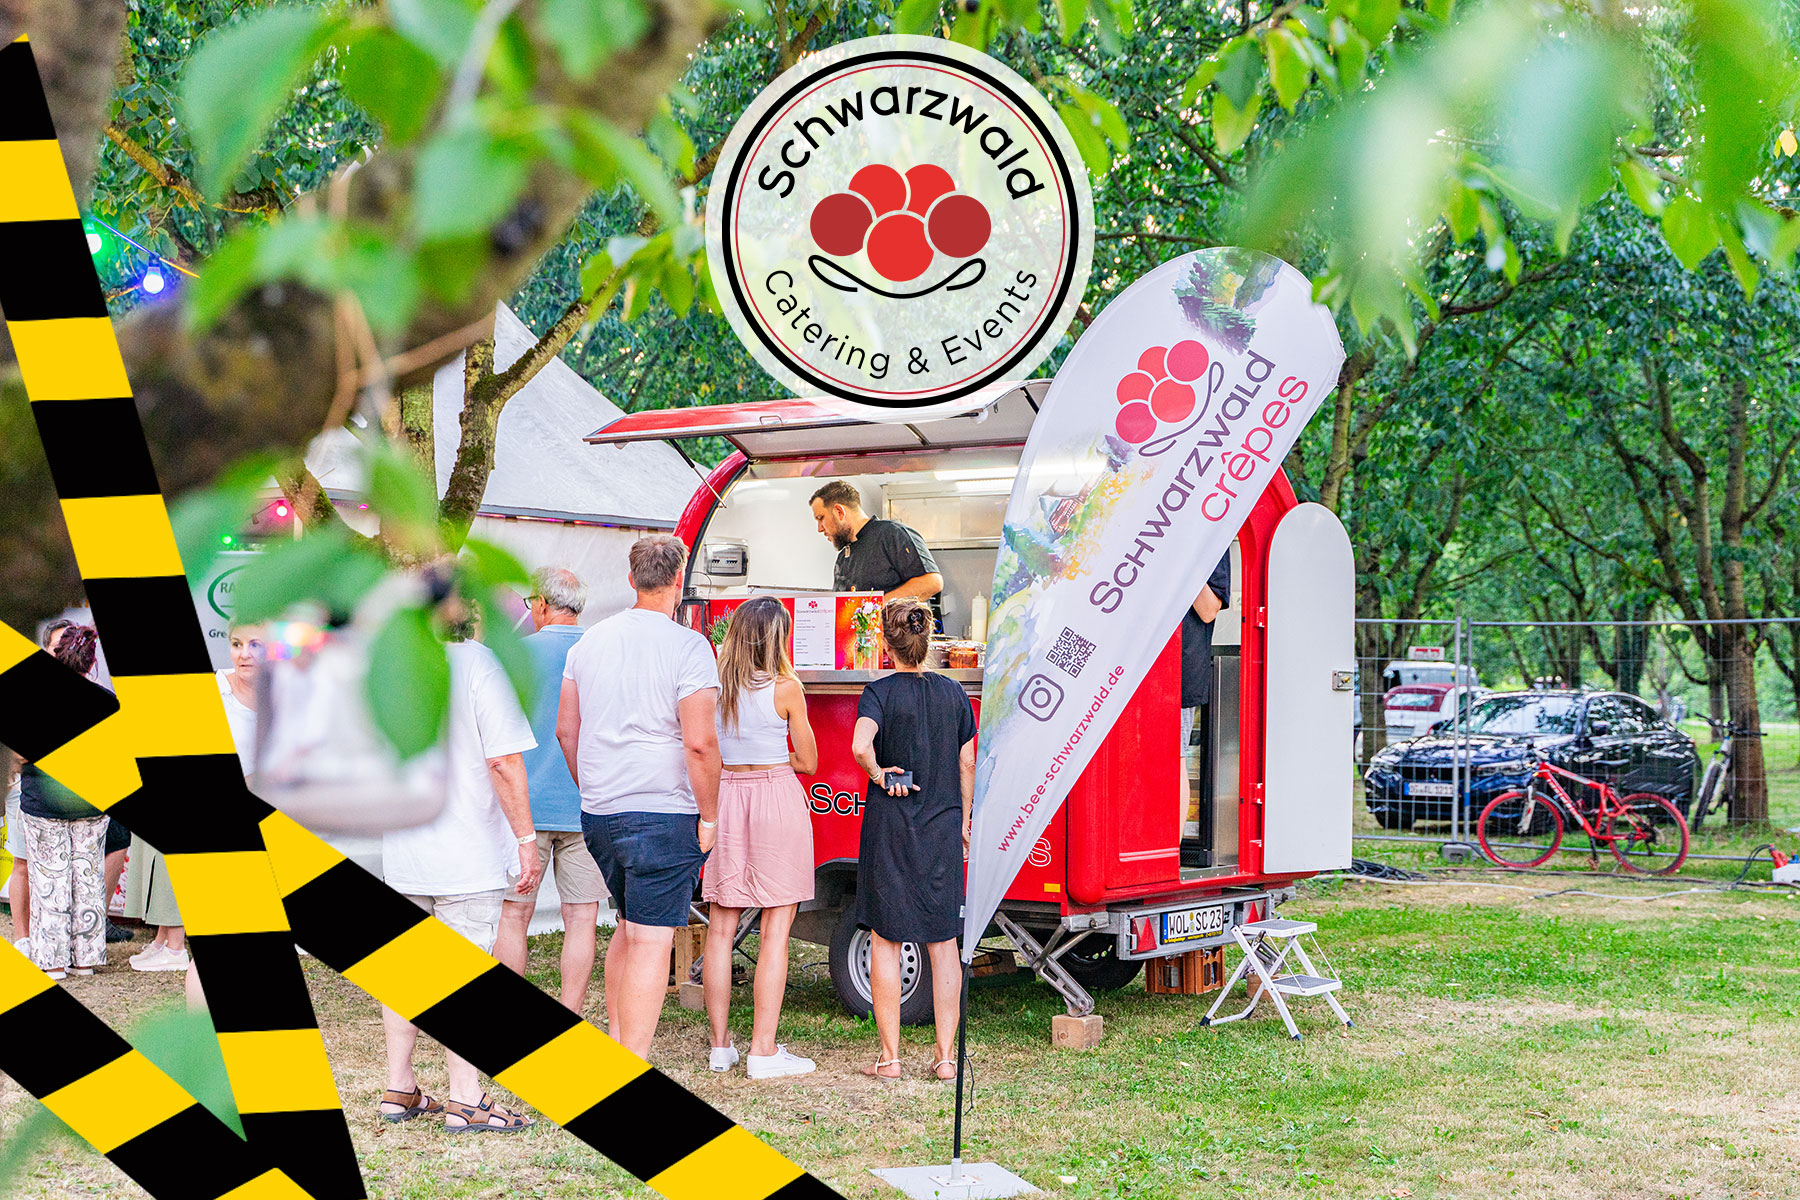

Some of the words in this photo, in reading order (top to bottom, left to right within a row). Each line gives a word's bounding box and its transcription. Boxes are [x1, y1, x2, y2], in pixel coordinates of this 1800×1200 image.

[1201, 376, 1309, 522] crêpes
[998, 665, 1125, 852] www.bee-schwarzwald.de
[1169, 915, 1189, 935] WOL
